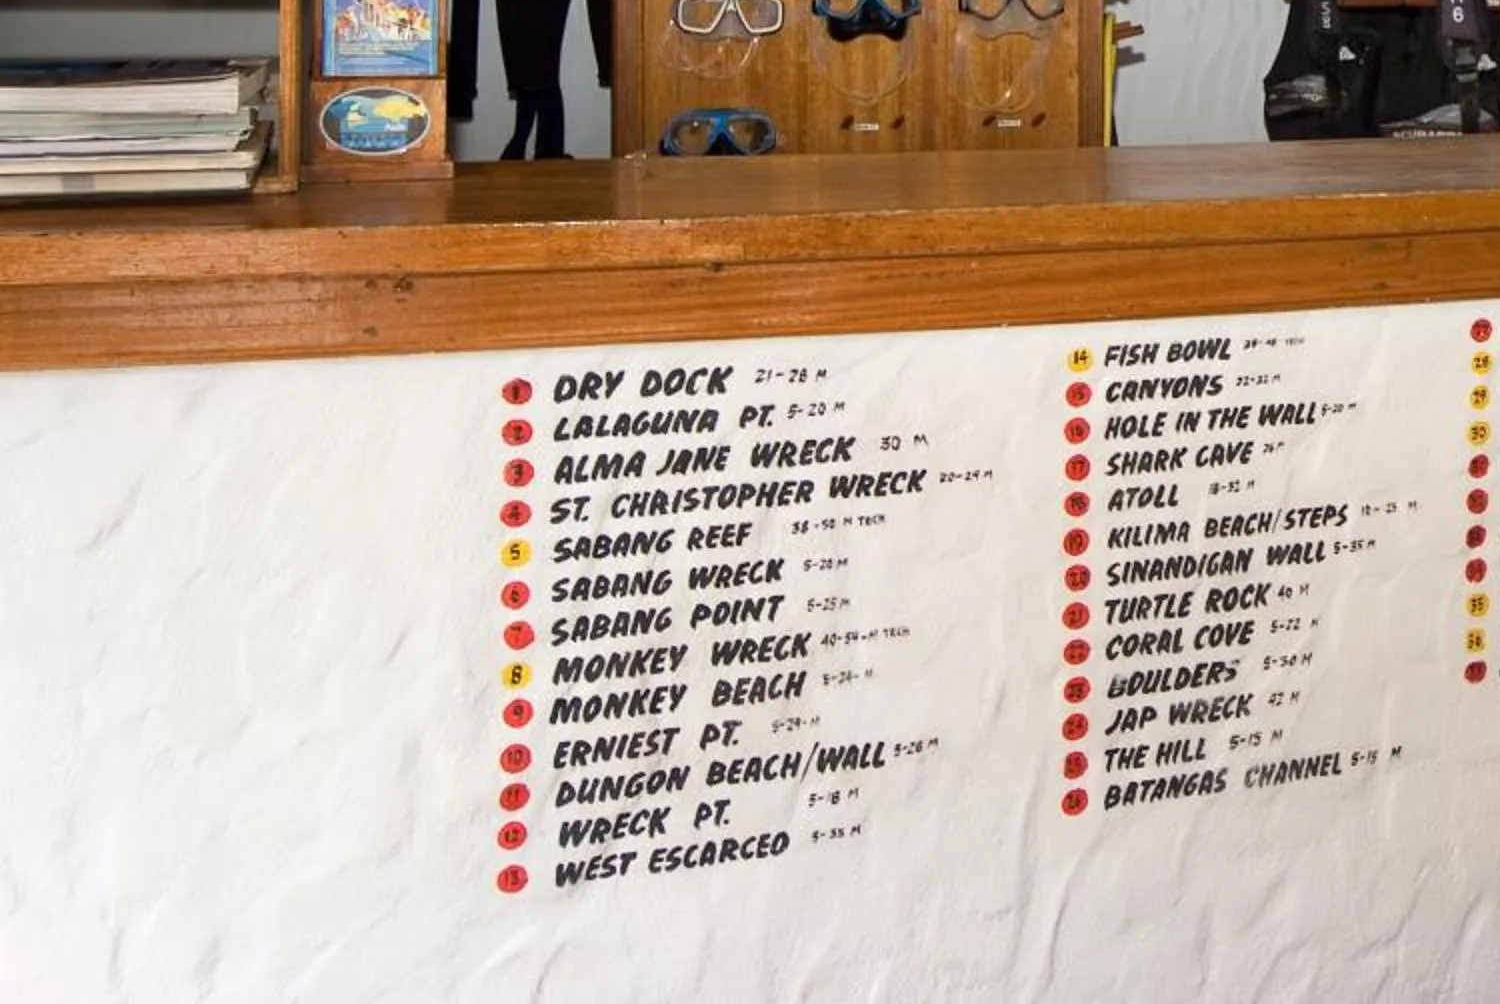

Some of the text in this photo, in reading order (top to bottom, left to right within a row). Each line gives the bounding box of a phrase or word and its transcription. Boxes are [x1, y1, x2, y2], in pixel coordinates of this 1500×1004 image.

[1104, 343, 1160, 368] FISH
[1166, 338, 1231, 363] BOWL
[553, 370, 625, 404] DRY
[640, 366, 734, 398] DOCK
[755, 368, 808, 383] 21-28
[1105, 374, 1223, 404] CANYONS
[553, 408, 719, 442] LALAGUNA
[739, 404, 776, 429] PT.
[787, 402, 826, 420] 5-20
[1104, 401, 1316, 441] HOLE IN THE WALL
[554, 450, 647, 485] ALMA
[655, 445, 731, 476] JANE
[750, 436, 856, 469] WRECK
[880, 436, 901, 451] 30
[1104, 446, 1188, 476] SHARK
[1195, 441, 1254, 468] CAVE
[549, 496, 591, 524] ST.
[611, 480, 815, 519] CHRISTOPHER
[829, 469, 927, 499] WRECK
[1108, 484, 1178, 512] ATOLL
[552, 528, 675, 564] SABANG
[686, 522, 753, 552] REEF
[1107, 520, 1191, 550] KILIMA
[1204, 504, 1348, 539] BEACH/STEPS
[552, 569, 673, 603] SABANG
[688, 558, 785, 590] WRECK
[1106, 548, 1254, 587] SINANDIGAN
[1266, 540, 1326, 566] WALL
[551, 606, 672, 647] SABANG
[689, 594, 785, 630] POINT
[1104, 591, 1195, 625] TURTLE
[1204, 582, 1272, 614] ROCK
[552, 644, 688, 686] MONKEY
[711, 632, 812, 667] WRECK
[1105, 627, 1184, 661] CORAL
[1193, 620, 1255, 651] COVE
[549, 684, 688, 725] MONKEY
[711, 670, 808, 708] BEACH
[1107, 659, 1240, 701] BOULDERS
[1104, 706, 1158, 736] JAP
[1168, 693, 1254, 726] WRECK
[553, 727, 681, 770] ERNIEST
[699, 719, 741, 750] PT.
[1104, 744, 1150, 773] THE
[1155, 737, 1206, 767] HILL
[555, 765, 691, 808] DUNGON
[704, 739, 885, 787] BEACH/WALL
[1104, 767, 1228, 811] BATANGAS
[1244, 752, 1342, 788] CHANNEL
[559, 806, 670, 850] WRECK
[693, 798, 731, 830] PT.
[555, 851, 638, 888] WEST
[648, 831, 790, 874] ESCARCEO
